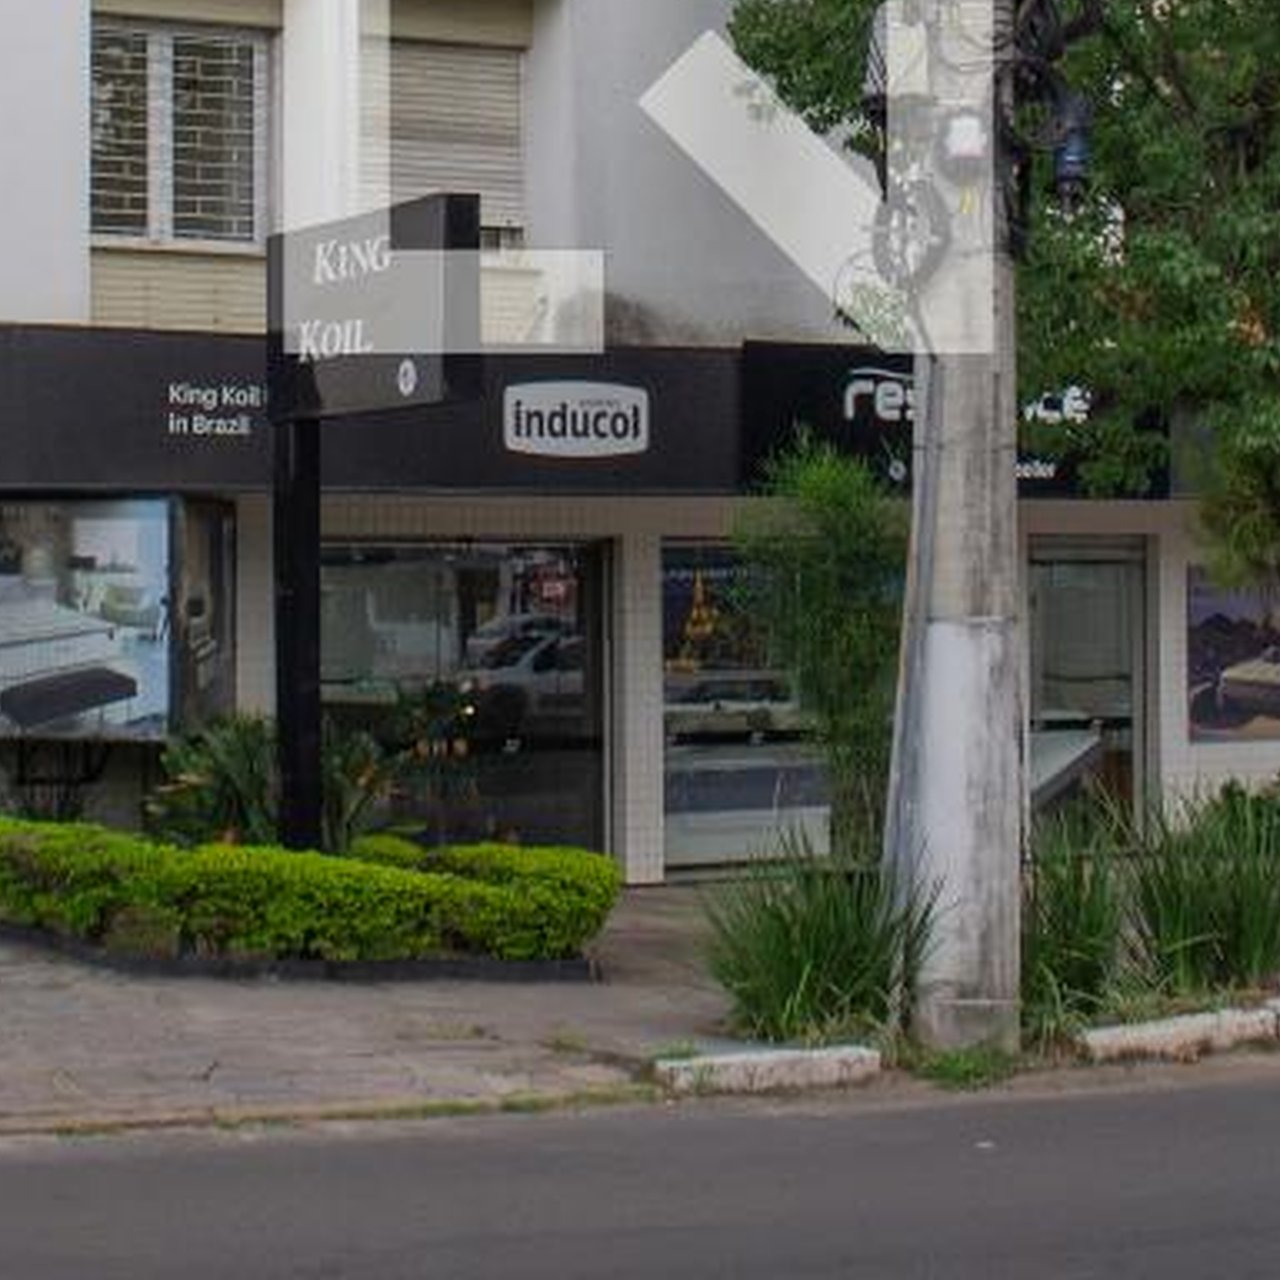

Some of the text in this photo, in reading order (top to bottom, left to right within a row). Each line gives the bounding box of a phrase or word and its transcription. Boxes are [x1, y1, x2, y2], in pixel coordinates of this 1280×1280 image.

[314, 236, 393, 285] KING
[299, 319, 373, 364] KOIL
[168, 384, 218, 411] King
[193, 413, 251, 435] Brazil
[514, 400, 640, 440] inducol
